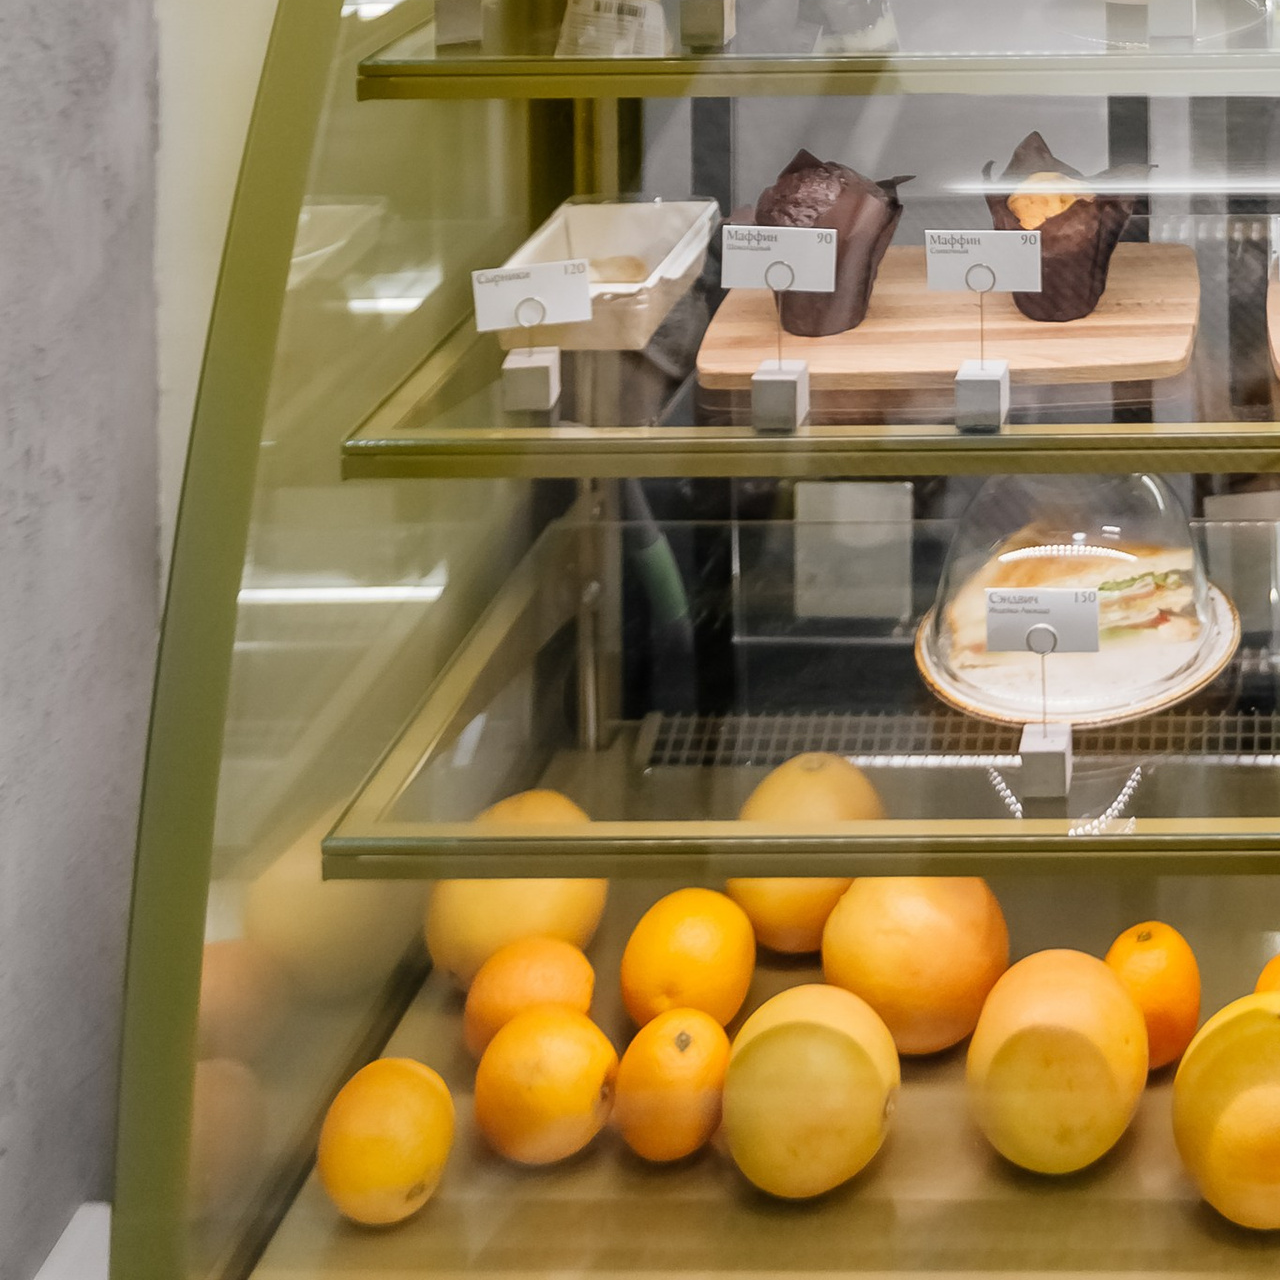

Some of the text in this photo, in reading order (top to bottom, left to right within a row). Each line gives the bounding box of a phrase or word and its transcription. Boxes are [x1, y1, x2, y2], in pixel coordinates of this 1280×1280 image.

[727, 230, 778, 245] Маффин
[817, 233, 832, 244] 90
[930, 234, 981, 248] Маффин
[1021, 235, 1036, 245] 90
[564, 263, 585, 274] 120
[989, 593, 1038, 604] Сэндвич
[1074, 592, 1096, 602] 150
